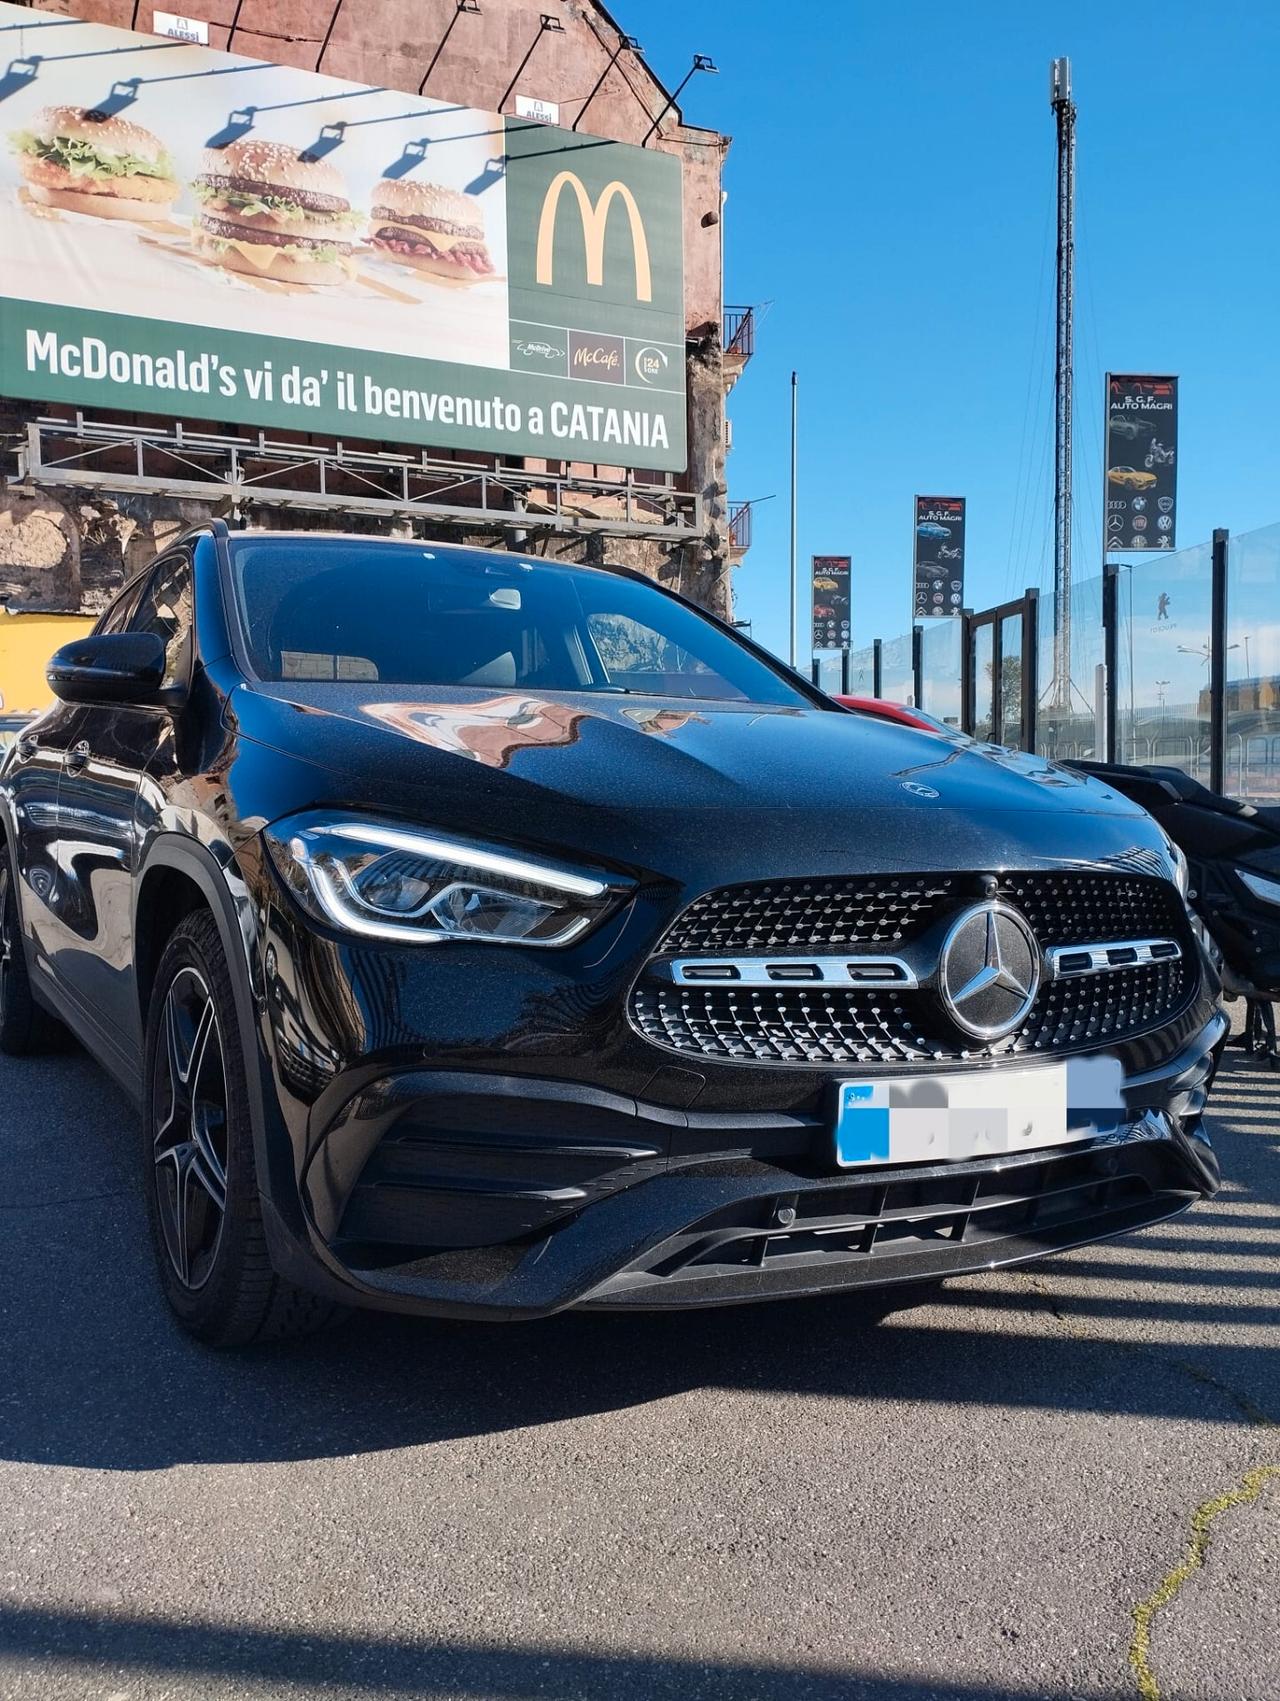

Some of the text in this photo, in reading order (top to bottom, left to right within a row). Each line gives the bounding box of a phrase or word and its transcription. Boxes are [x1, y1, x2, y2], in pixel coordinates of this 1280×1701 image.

[647, 357, 660, 369] 24
[26, 329, 669, 449] McDonald's vi da' il benvenuto a CATANIA
[1111, 402, 1139, 410] AUTO
